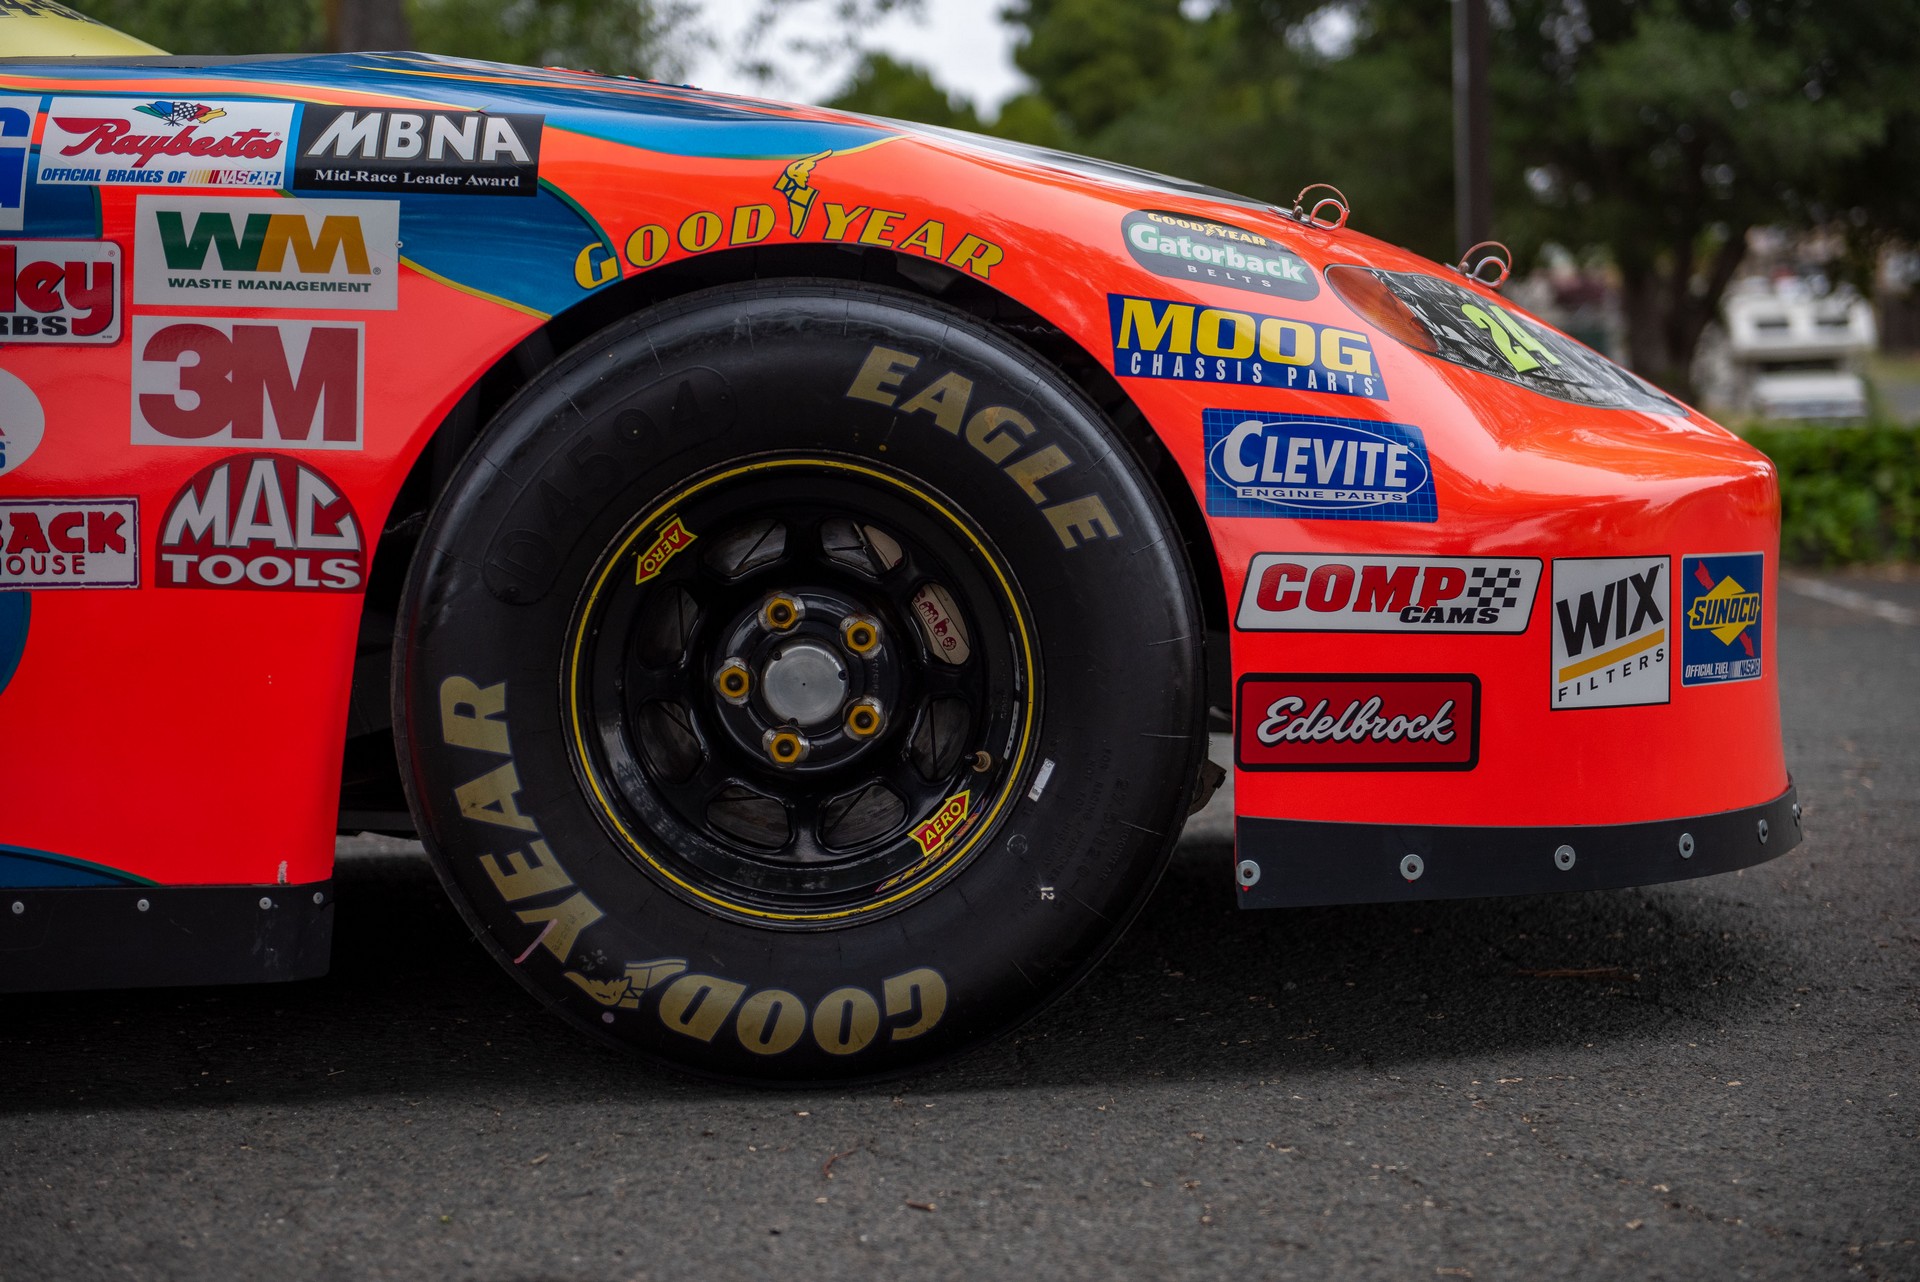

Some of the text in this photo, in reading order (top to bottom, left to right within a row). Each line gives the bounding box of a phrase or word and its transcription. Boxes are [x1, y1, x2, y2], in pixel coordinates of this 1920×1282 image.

[52, 117, 283, 168] Raybestos
[305, 111, 533, 163] MBNA
[41, 168, 282, 185] OFFICIAL BRAKES OF NASCAR
[315, 169, 519, 188] Mid-Race Leader Award
[156, 211, 372, 274] WM
[1129, 223, 1306, 283] Gatorback
[168, 277, 372, 294] WASTE MANAGEMENT
[1187, 264, 1272, 287] BELTS
[1117, 298, 1373, 376] MOOG
[139, 323, 359, 442] 3M
[1130, 352, 1374, 397] CHASSIS PARTS
[846, 345, 1121, 549] EAGLE
[1223, 420, 1409, 488] CLEVITE
[162, 458, 361, 552] MAC
[1241, 488, 1404, 502] ENGINE PARTS
[0, 511, 126, 554] ACK
[643, 528, 680, 573] AERO
[0, 554, 86, 575] OUSE
[162, 554, 361, 589] TOOLS
[1255, 563, 1467, 613] COMP
[1399, 605, 1501, 625] CAMS
[1556, 565, 1663, 658] WIX
[1691, 595, 1759, 627] SUNOCO
[1557, 648, 1665, 702] FILTERS
[1685, 661, 1729, 678] OFFICIAL FUEL
[1256, 695, 1457, 749] Edelbrock
[924, 801, 962, 846] AERO
[1040, 886, 1056, 901] 12
